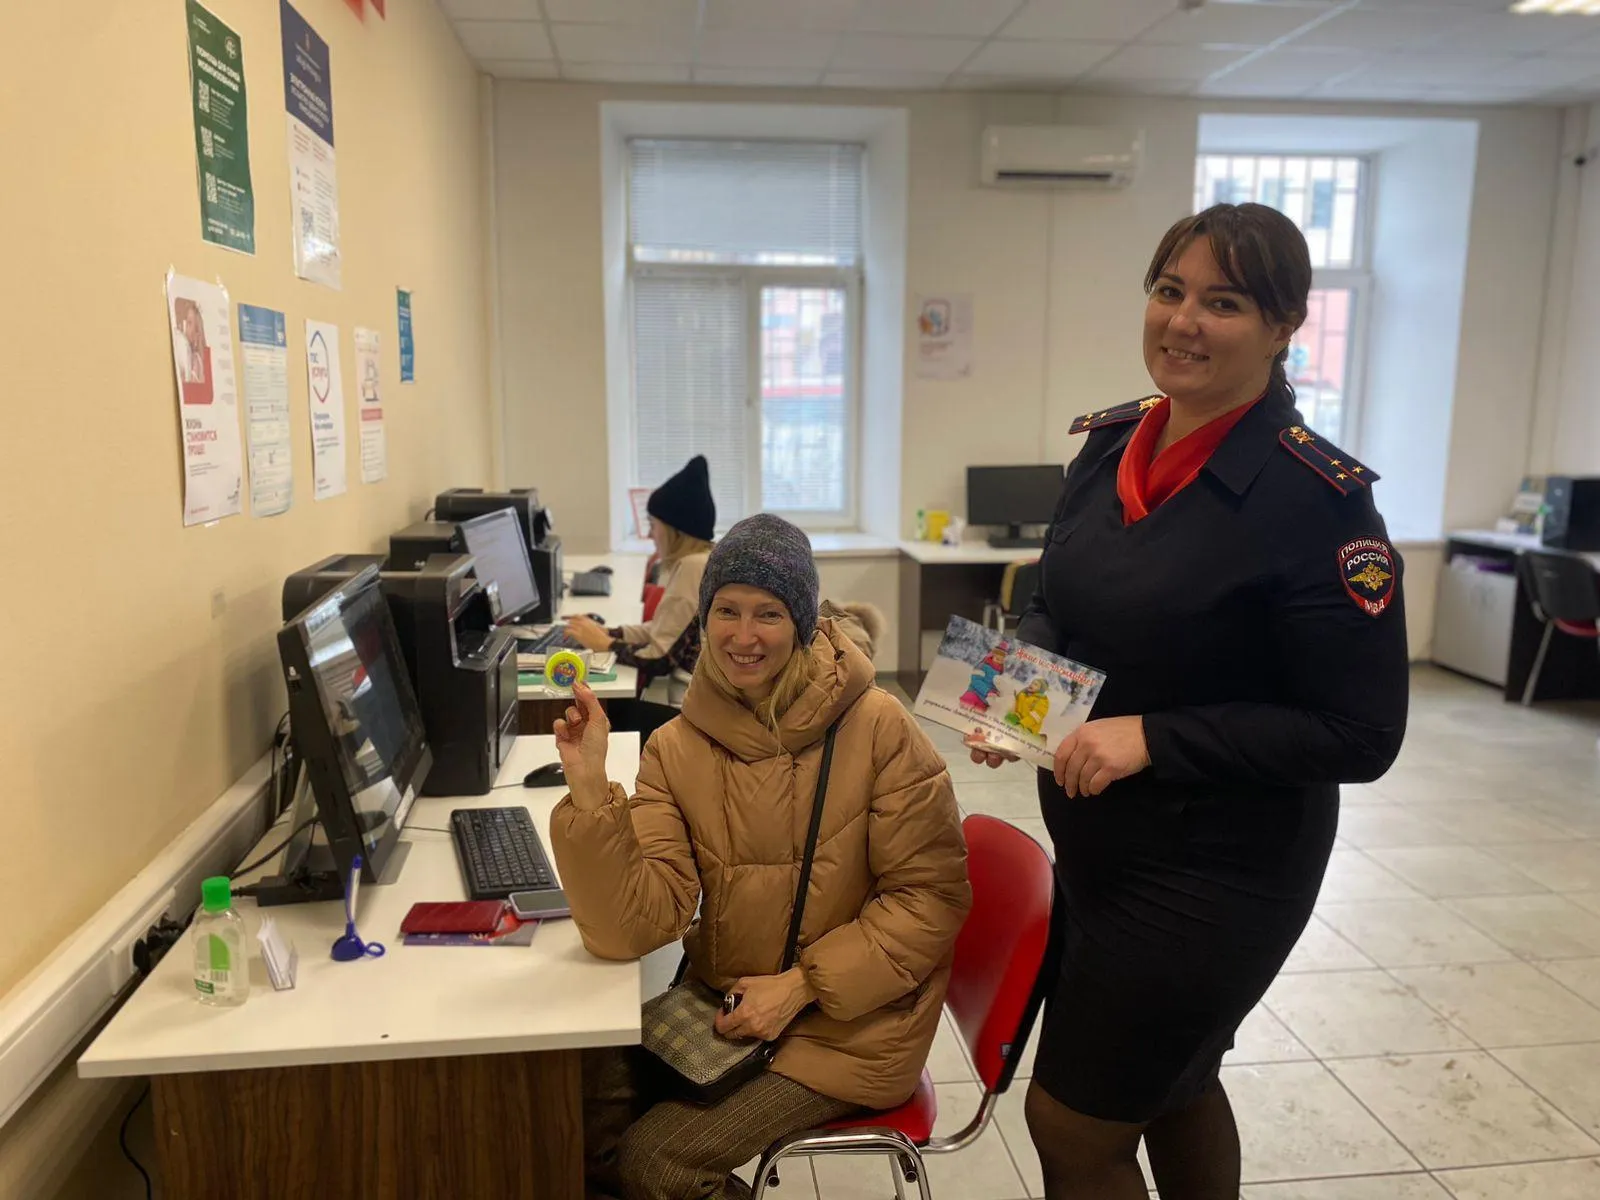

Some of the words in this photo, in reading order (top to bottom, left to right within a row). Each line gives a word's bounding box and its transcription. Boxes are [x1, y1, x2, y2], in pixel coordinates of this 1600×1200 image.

[1341, 539, 1388, 559] ПОЛИЦИЯ
[1346, 552, 1389, 570] РОССИЯ
[1364, 598, 1385, 613] МВД
